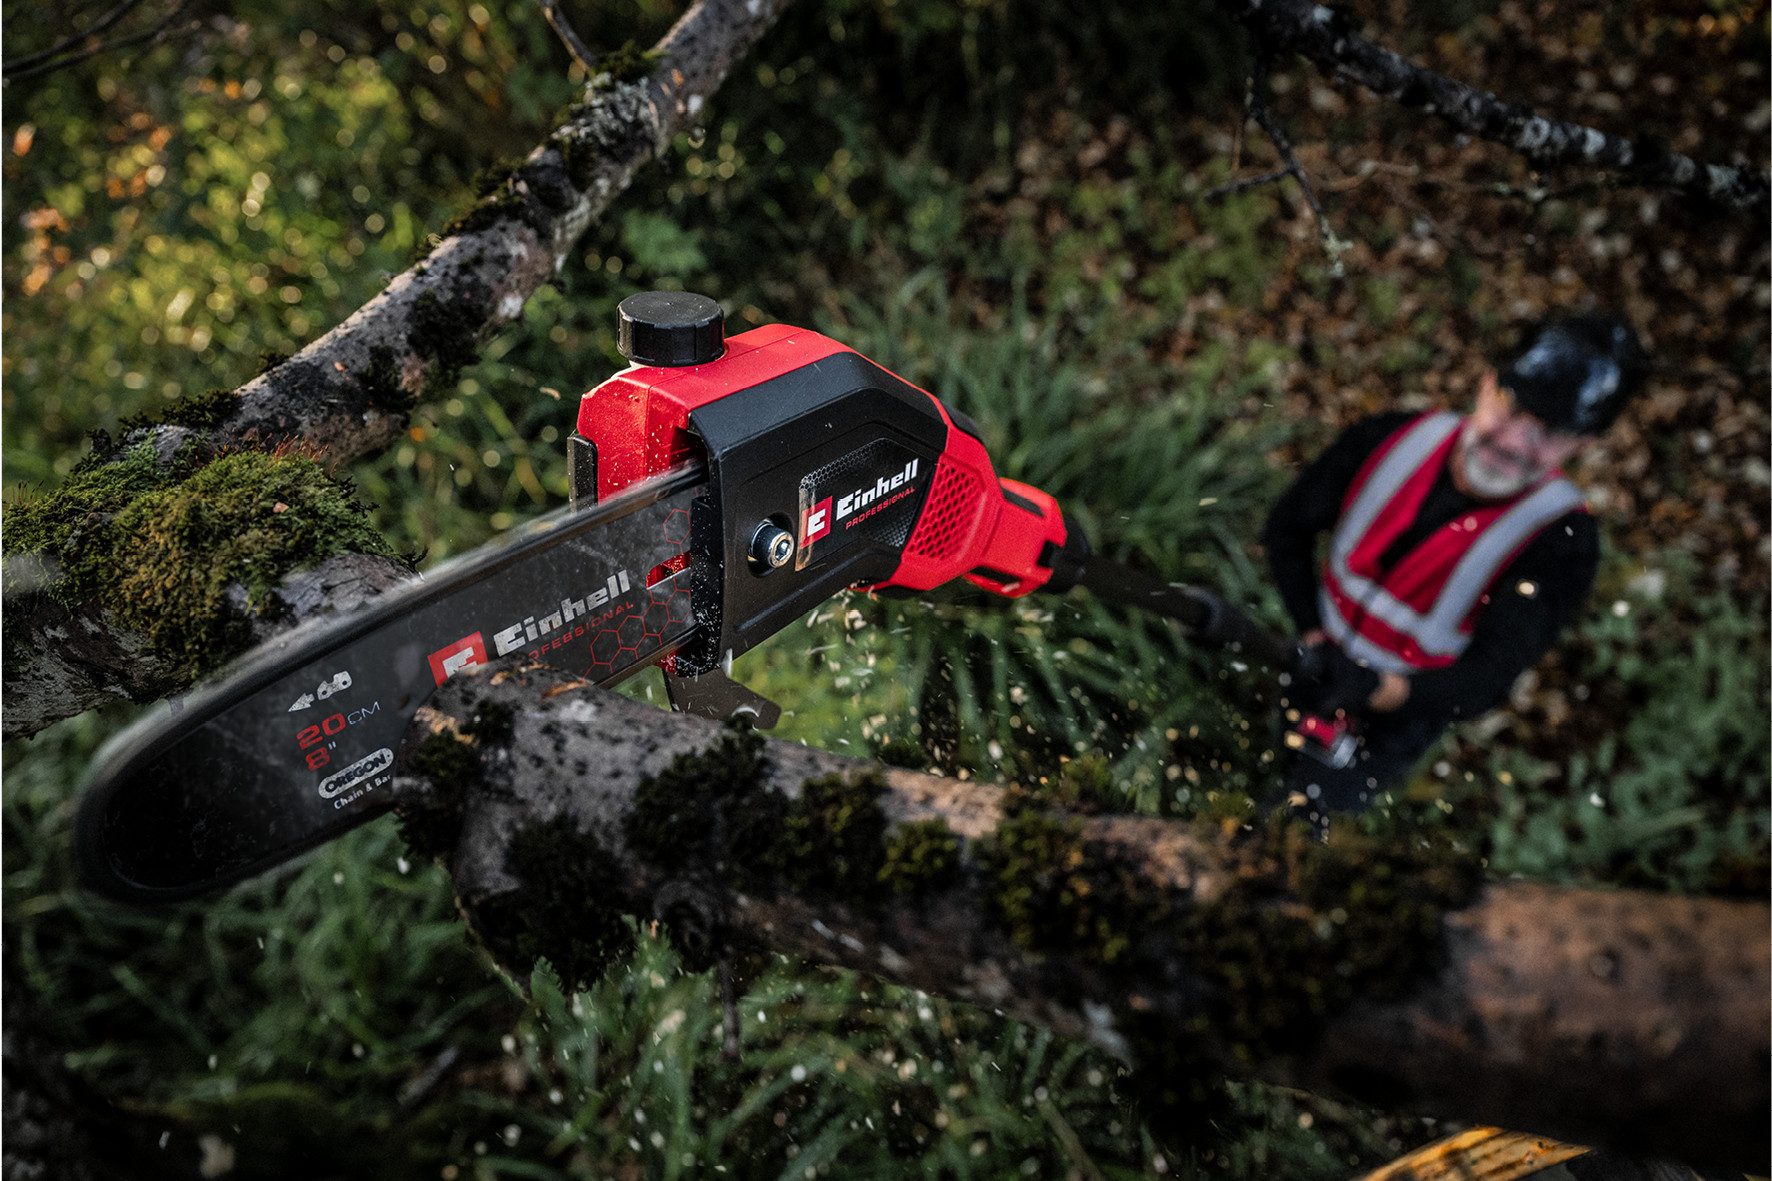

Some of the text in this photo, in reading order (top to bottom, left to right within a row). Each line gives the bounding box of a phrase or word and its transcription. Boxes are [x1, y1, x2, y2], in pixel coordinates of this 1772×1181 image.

[836, 458, 919, 521] Einhell
[845, 486, 916, 530] PROFESSIONAL
[493, 569, 631, 657] Einhell
[324, 753, 387, 792] OREGON
[334, 774, 391, 810] Chain & Bar
